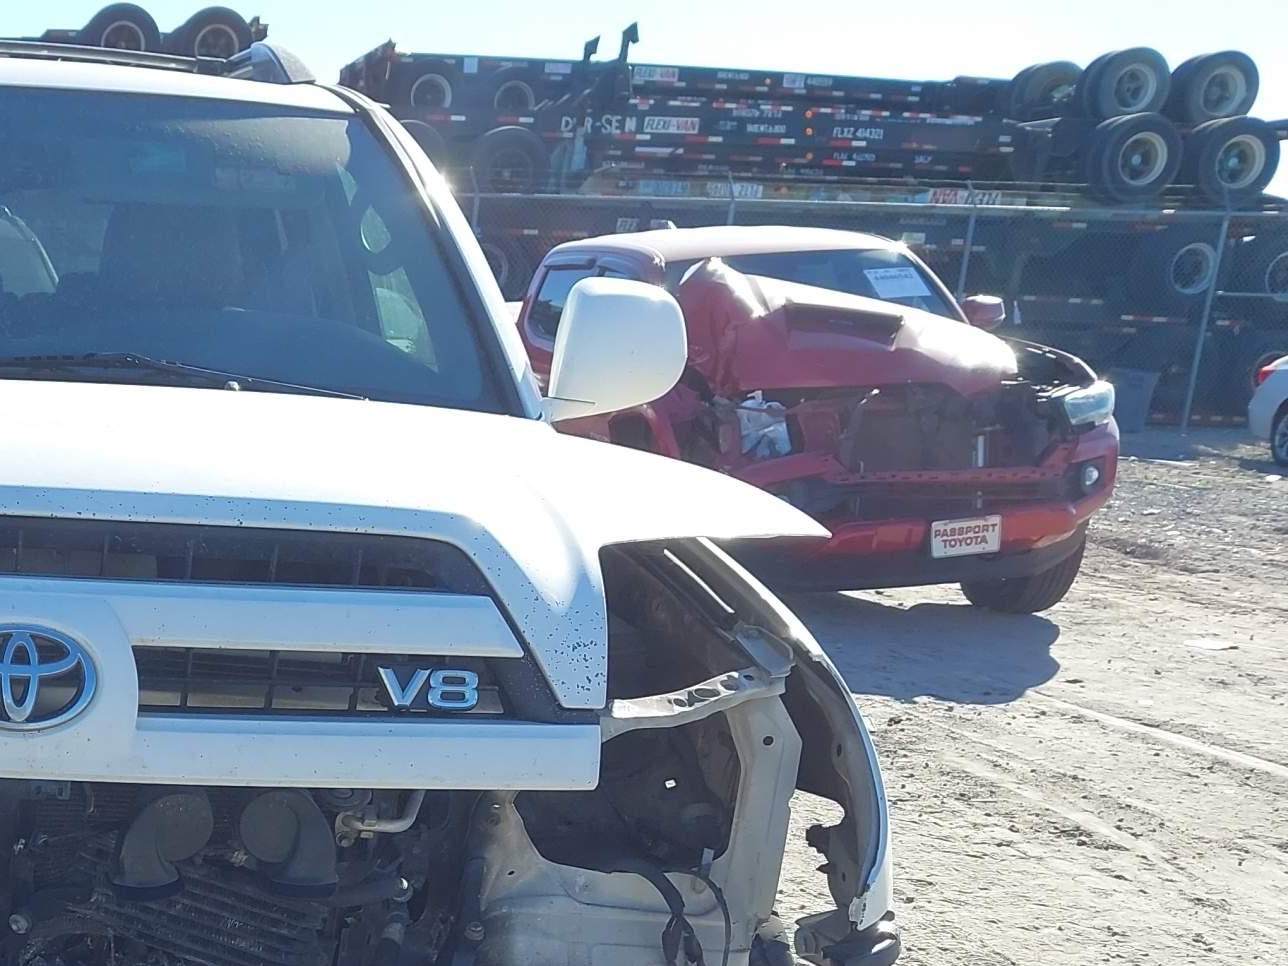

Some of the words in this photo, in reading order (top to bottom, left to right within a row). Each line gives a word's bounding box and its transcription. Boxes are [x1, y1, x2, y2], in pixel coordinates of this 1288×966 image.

[934, 523, 998, 538] PASSPORT
[941, 535, 988, 549] TOYOTA
[377, 666, 479, 711] V8
